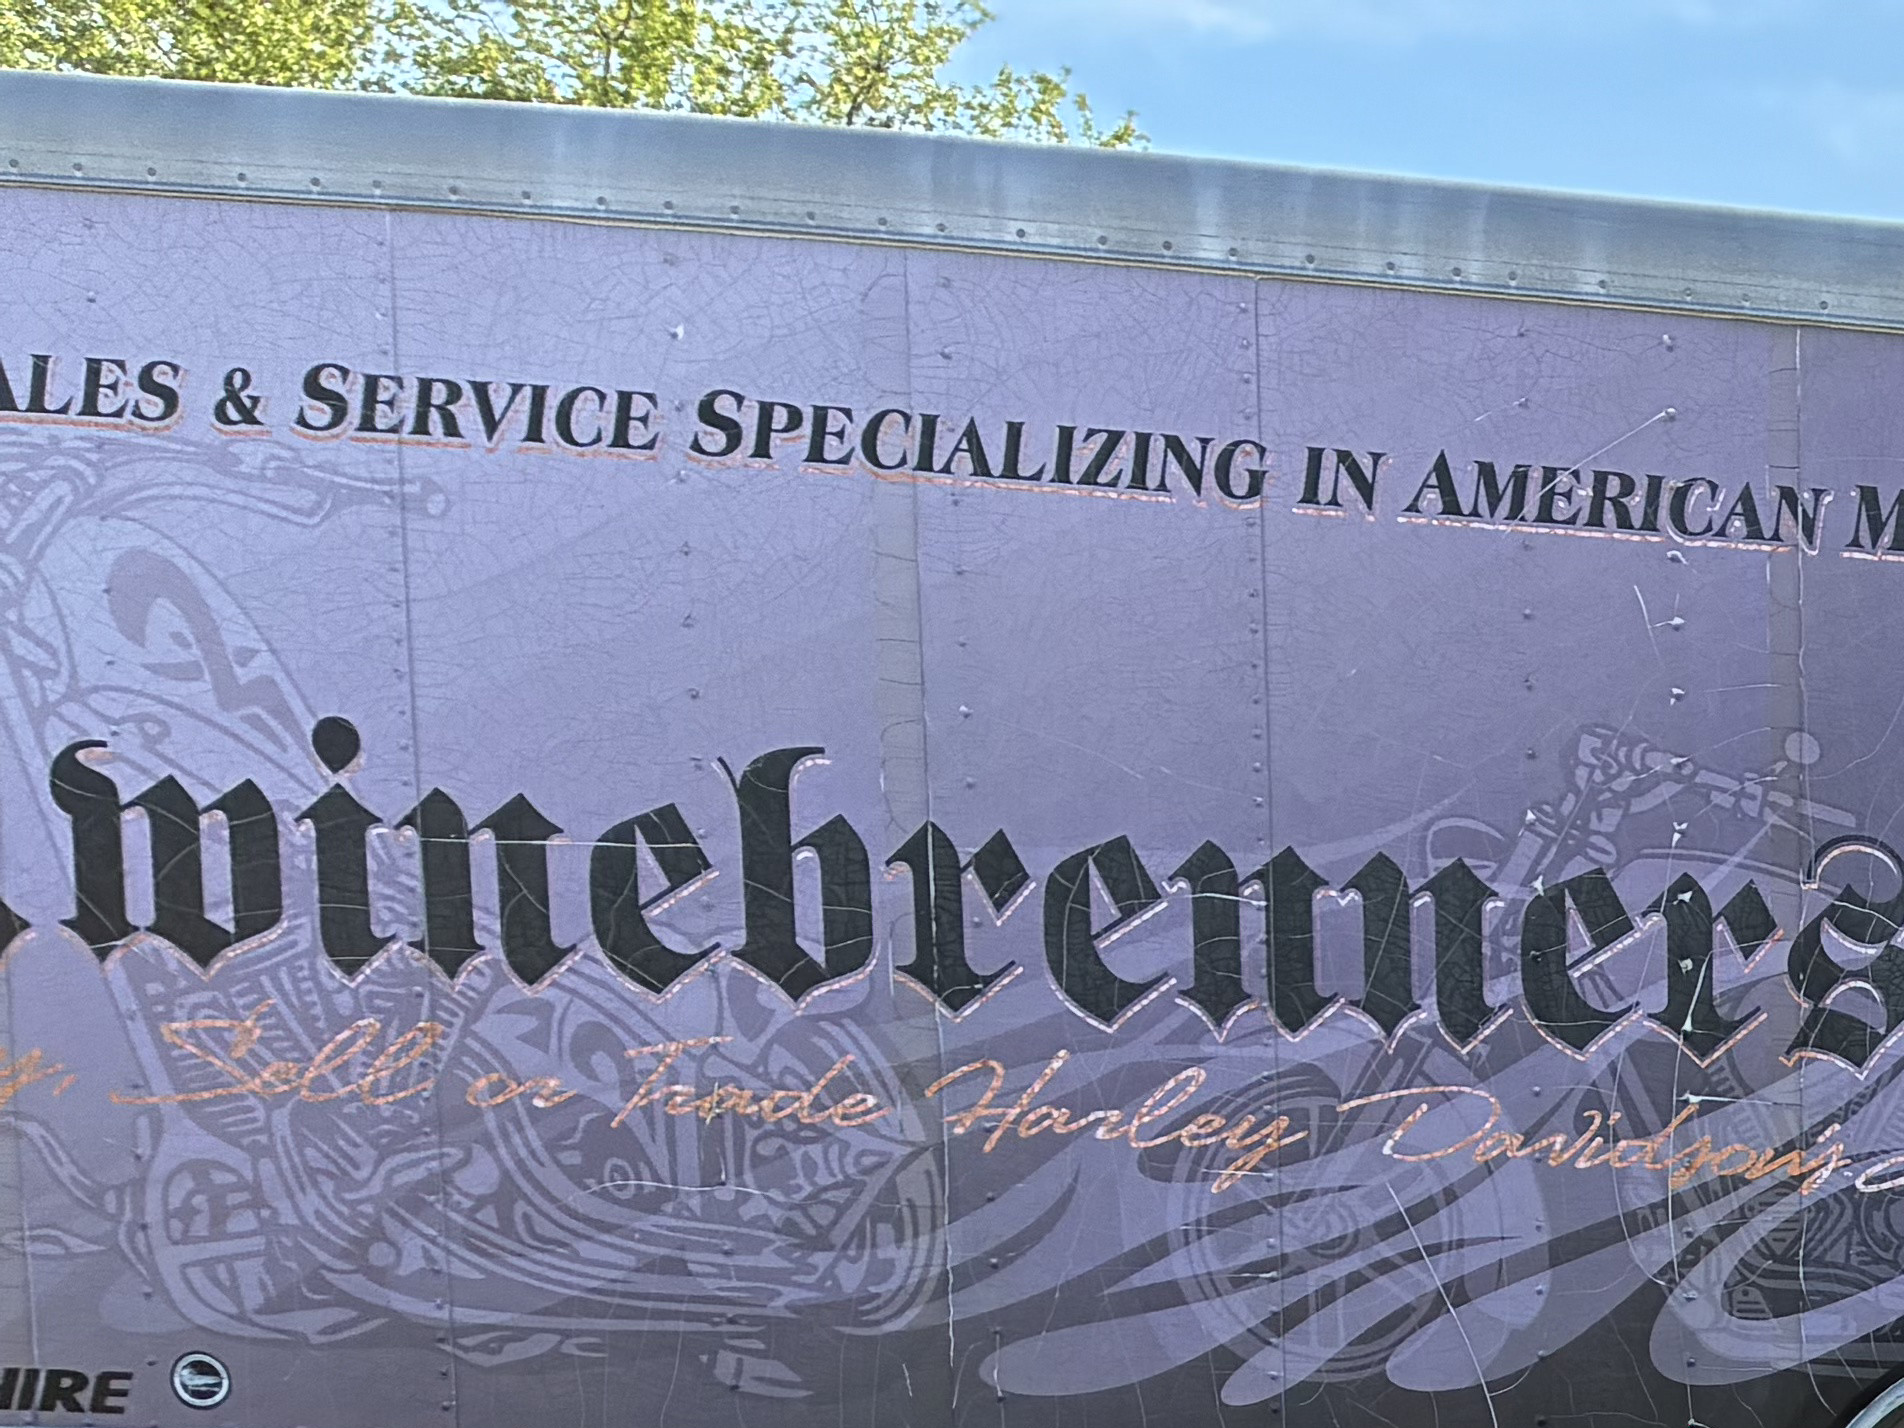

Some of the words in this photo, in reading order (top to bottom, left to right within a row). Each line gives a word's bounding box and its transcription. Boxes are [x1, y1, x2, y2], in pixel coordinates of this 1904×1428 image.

[212, 367, 265, 429] &
[294, 363, 661, 452] SERVICE
[688, 388, 1268, 500] SPECIALIZING
[1296, 446, 1390, 512] IN
[1400, 448, 1828, 549] AMERICAN
[466, 1072, 578, 1108] or
[610, 1035, 892, 1129] Trade
[924, 1048, 1308, 1194] Harley
